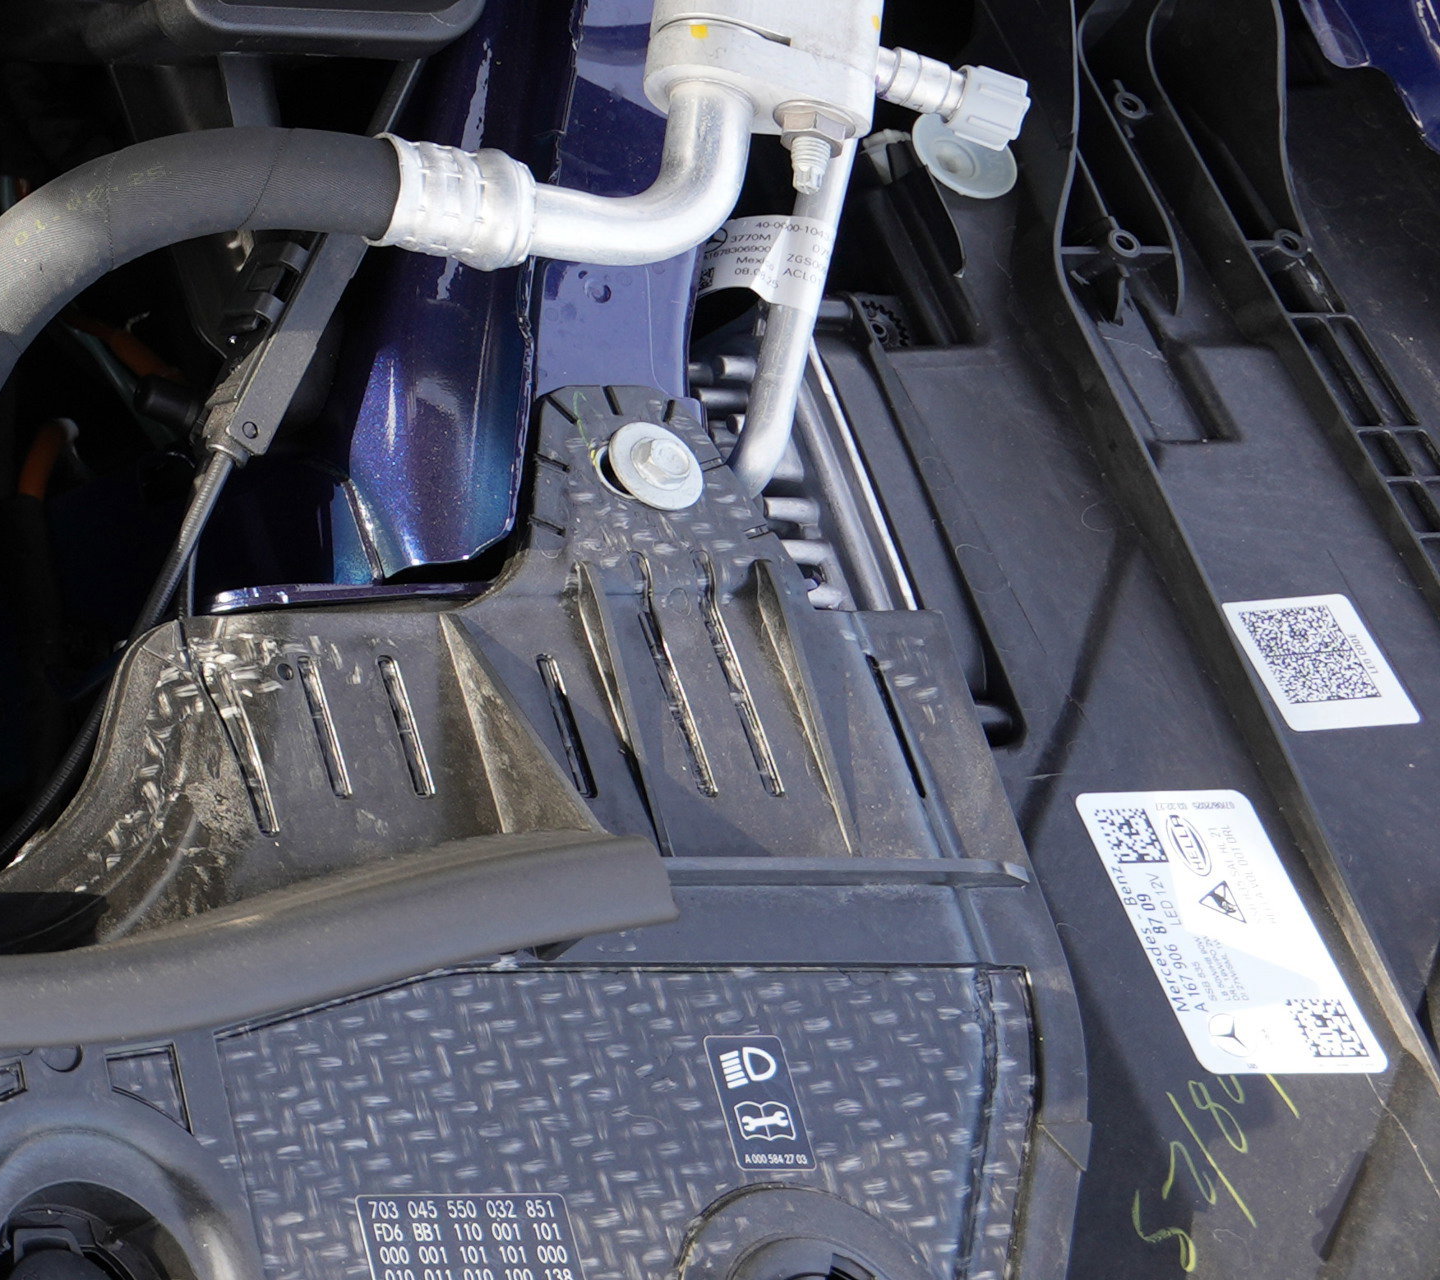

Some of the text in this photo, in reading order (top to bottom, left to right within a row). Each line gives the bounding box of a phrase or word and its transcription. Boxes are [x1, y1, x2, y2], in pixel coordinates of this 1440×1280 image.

[1166, 813, 1207, 870] HELLA
[1108, 865, 1140, 906] Benz
[1144, 871, 1183, 925] LED 12V
[1134, 892, 1210, 1013] A 167 906 87 09
[1137, 926, 1191, 1012] Mercedes
[745, 1154, 808, 1165] A 000 584 27 03
[368, 1199, 555, 1220] 703 045 550 032 851
[373, 1223, 562, 1242] FD6 BB1 110 001 101
[379, 1245, 568, 1265] 000 001 101 101 000
